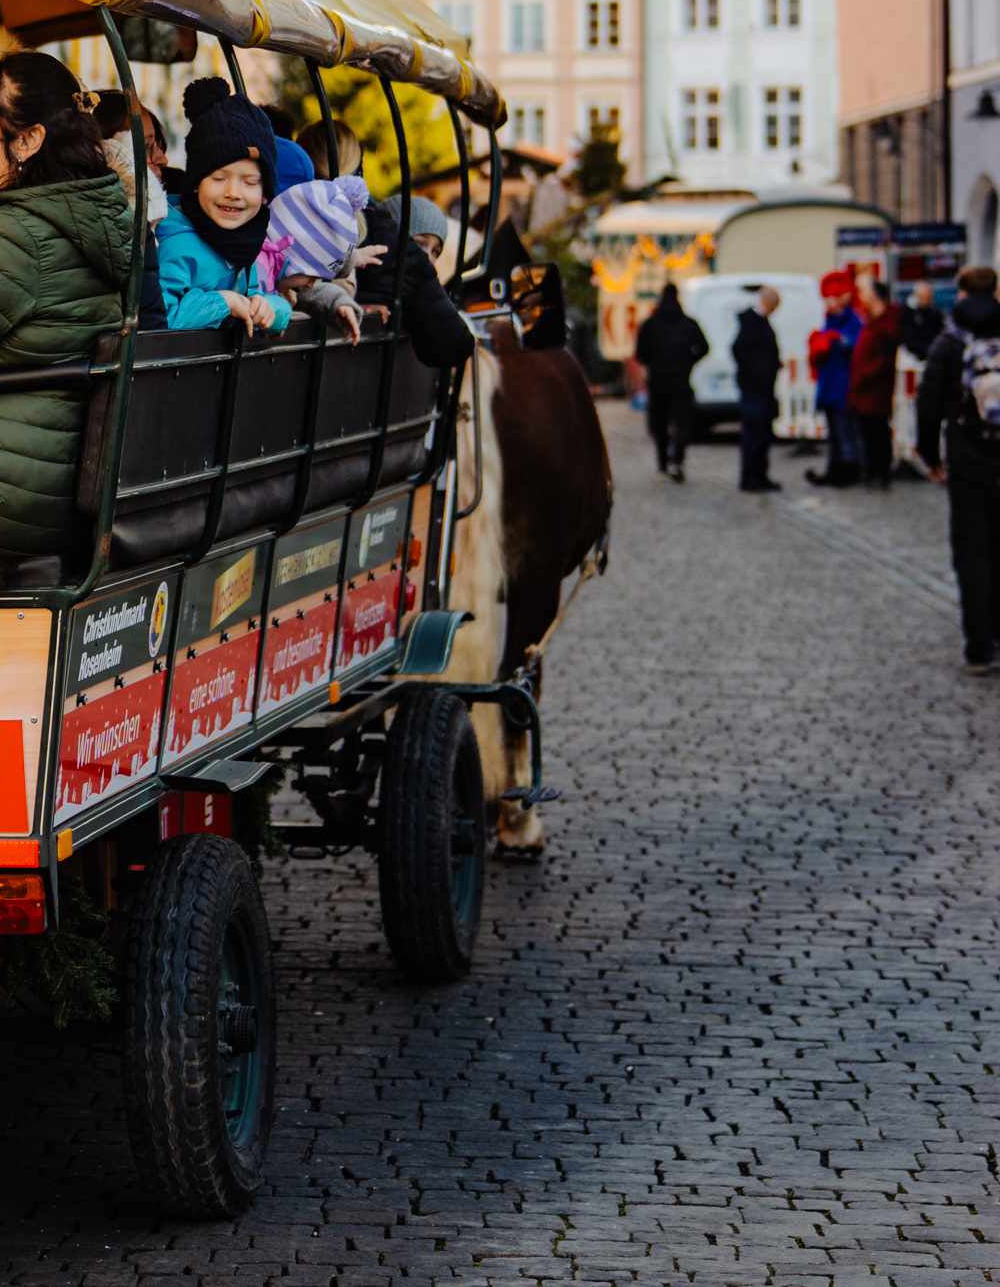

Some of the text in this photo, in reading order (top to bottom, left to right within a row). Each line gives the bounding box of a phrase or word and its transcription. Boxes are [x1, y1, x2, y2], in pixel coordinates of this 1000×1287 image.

[83, 596, 148, 645] Christkindlmarkt
[78, 639, 123, 681] Rosenheim
[76, 709, 141, 769] Wir wünschen
